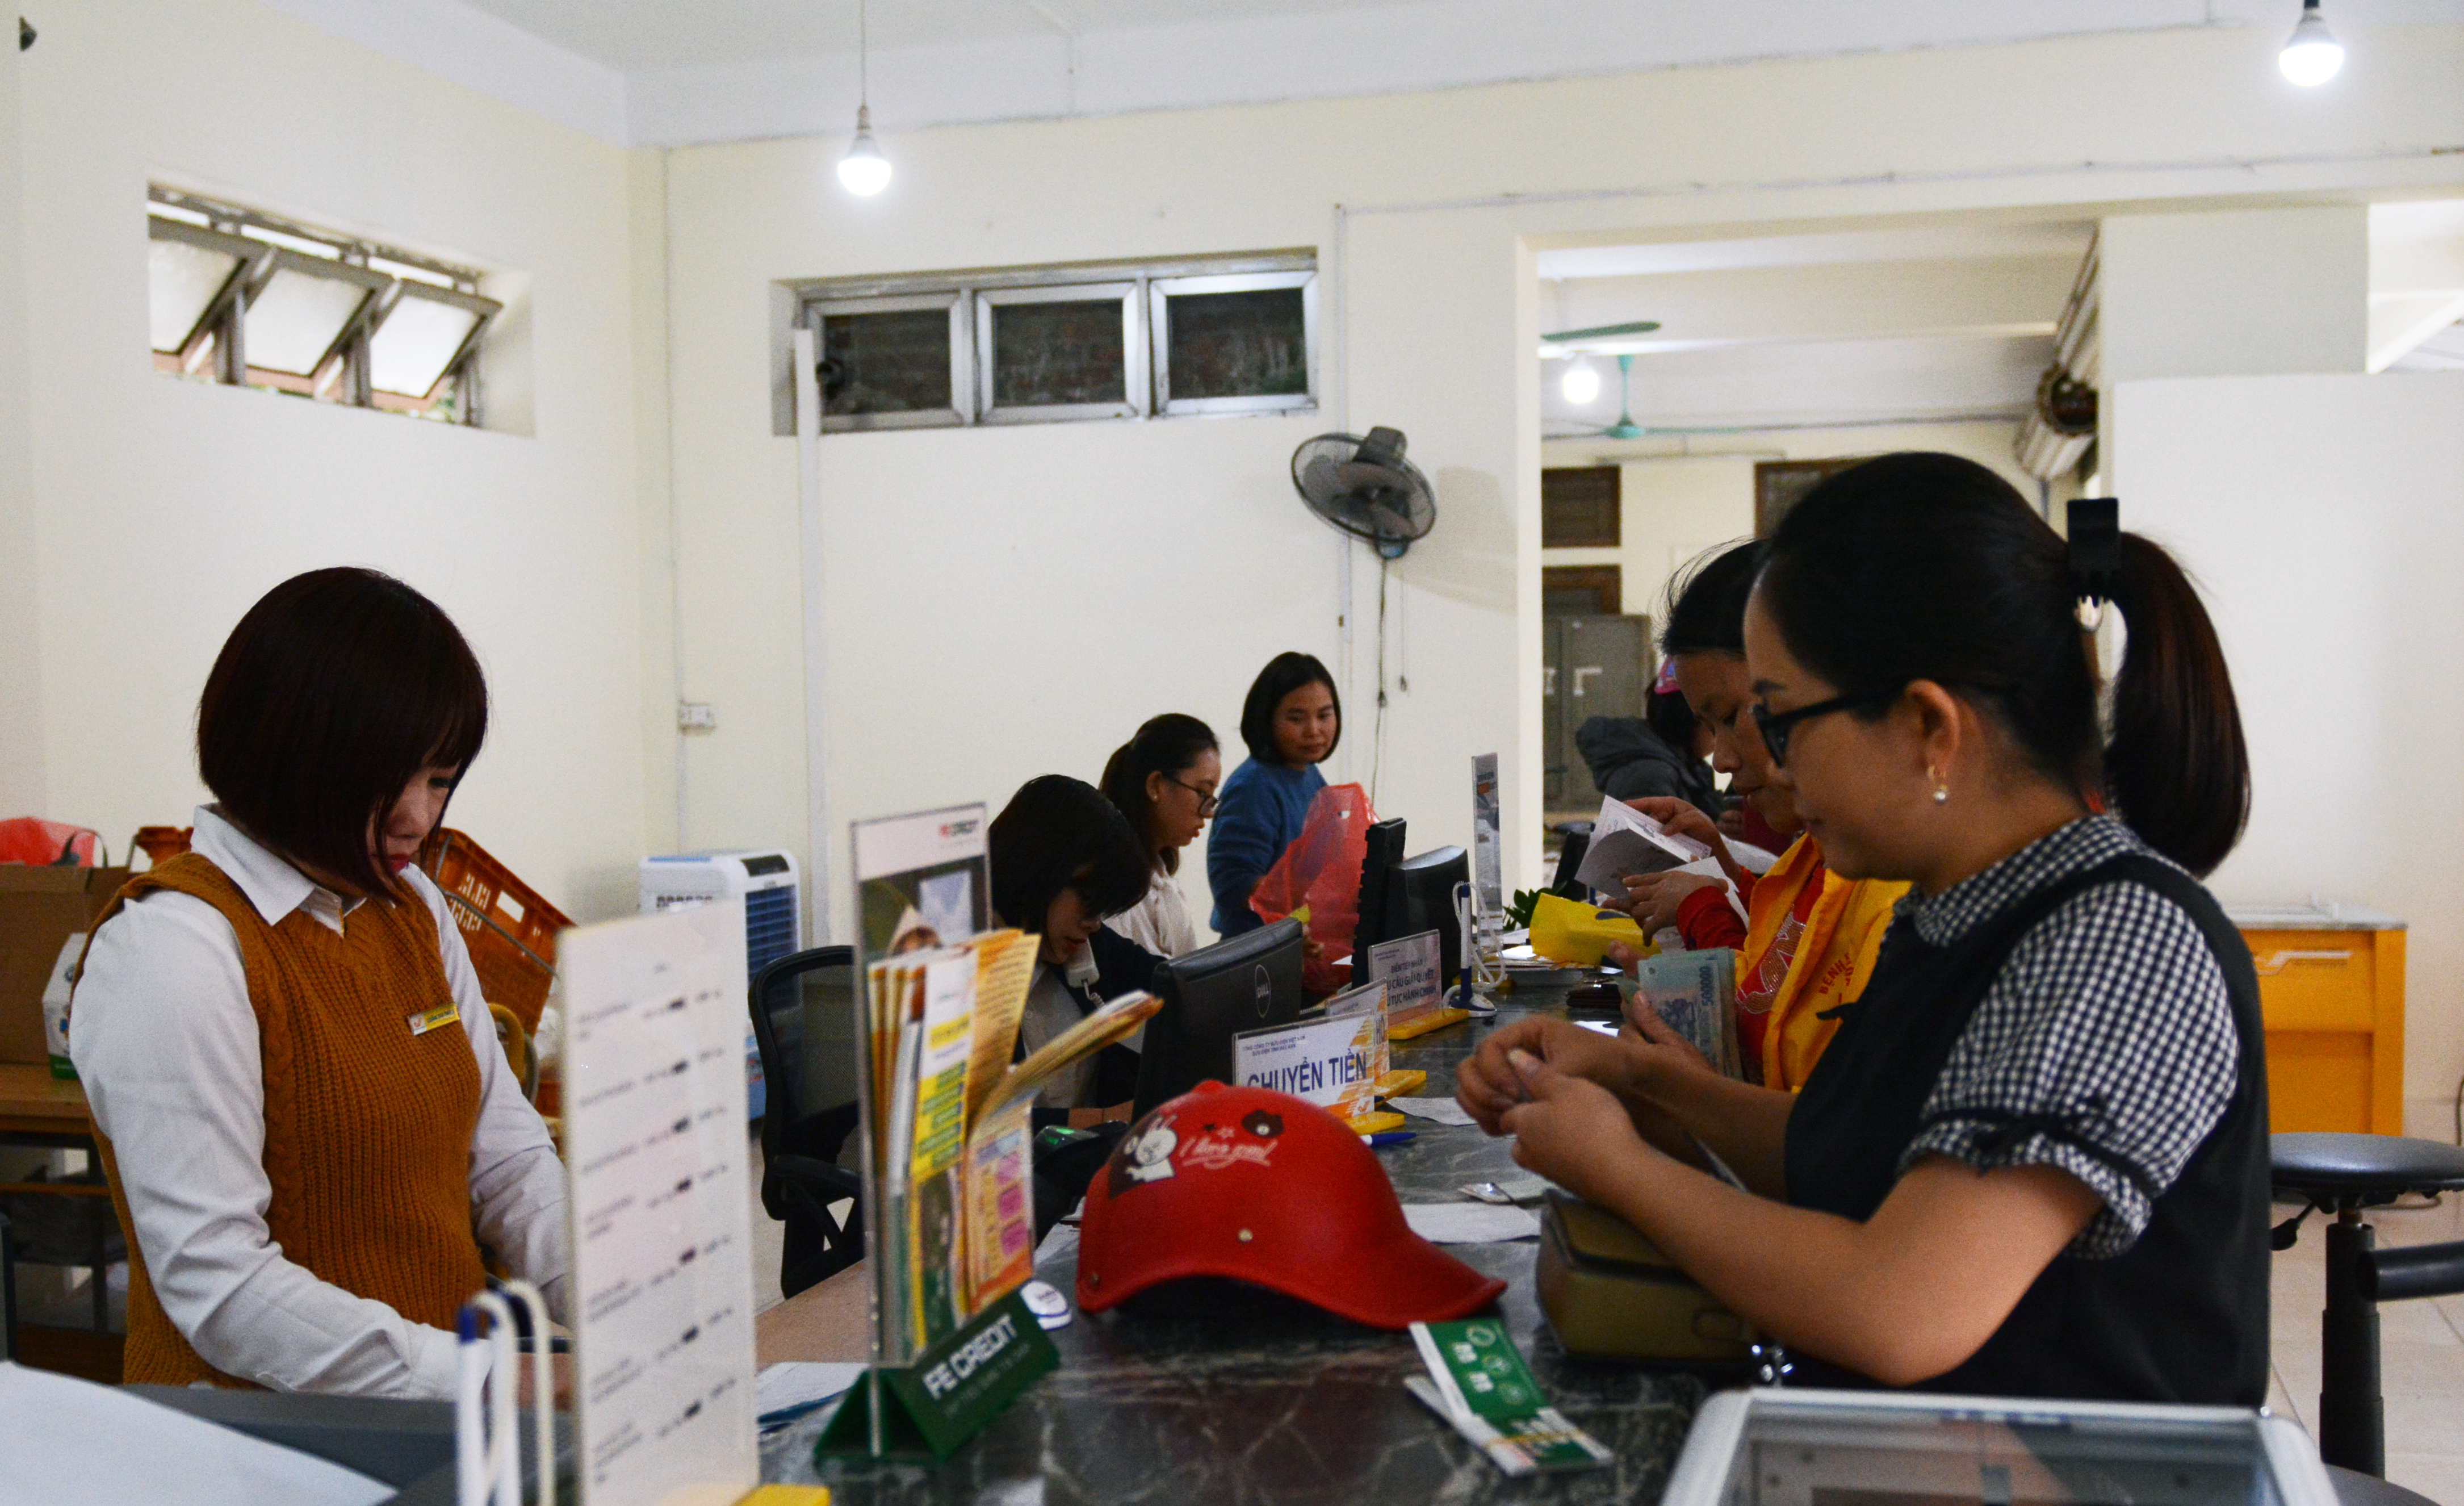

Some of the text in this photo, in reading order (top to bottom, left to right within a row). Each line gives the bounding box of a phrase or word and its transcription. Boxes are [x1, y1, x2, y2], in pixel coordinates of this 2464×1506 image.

[1329, 1048, 1367, 1086] TIỀN
[922, 1360, 959, 1400] FE
[949, 1313, 1018, 1379] CREDIT
